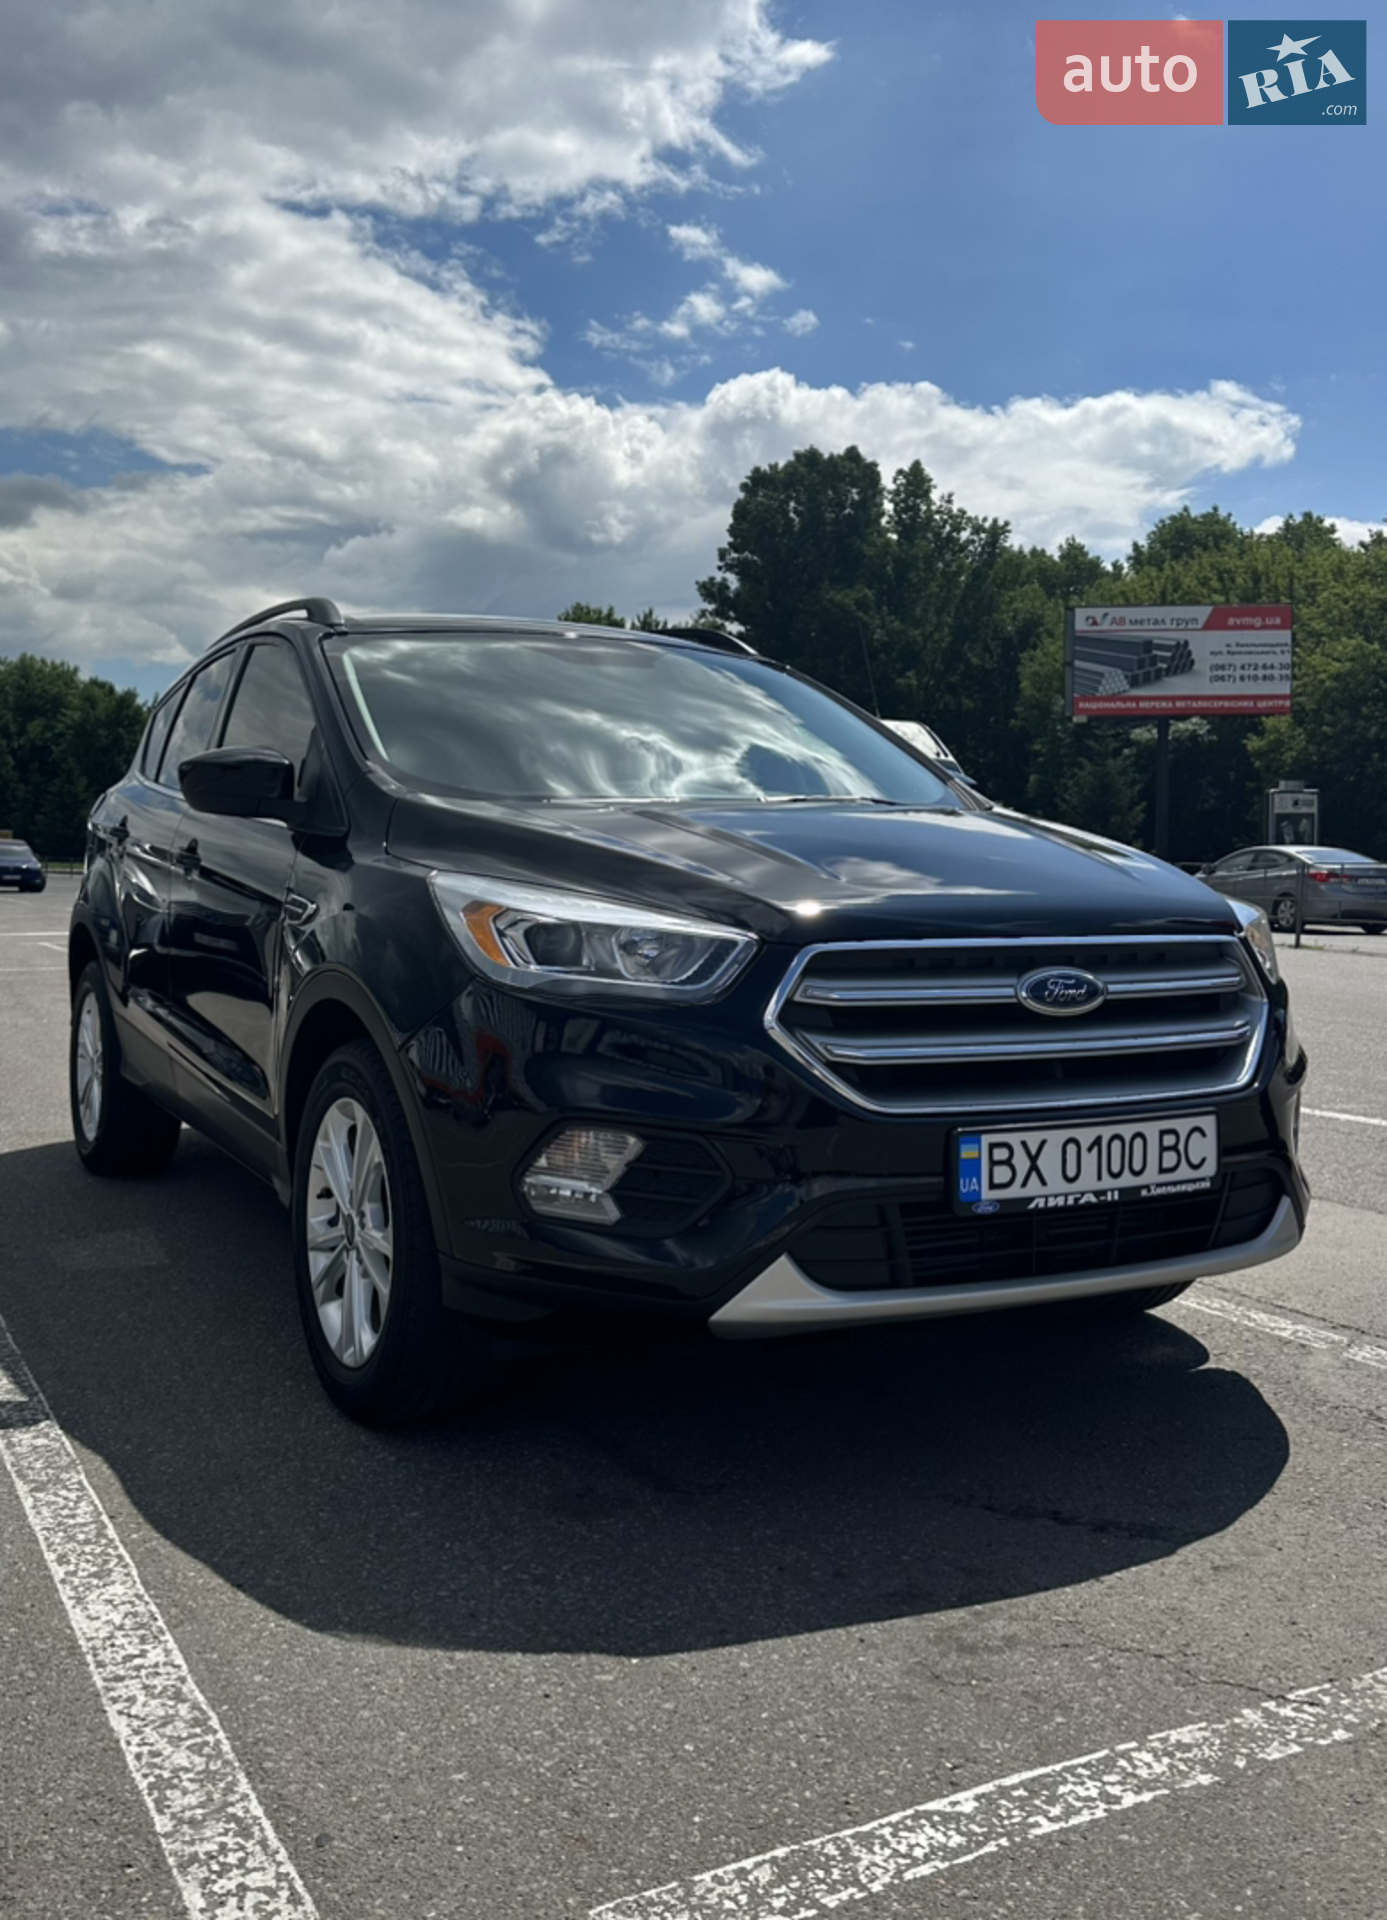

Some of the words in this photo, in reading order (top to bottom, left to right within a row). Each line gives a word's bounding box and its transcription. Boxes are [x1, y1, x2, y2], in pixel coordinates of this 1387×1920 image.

[1128, 617, 1167, 627] метал
[1170, 617, 1200, 629] груп
[1226, 616, 1282, 629] avmg.ua
[1209, 663, 1237, 673] (067)
[1239, 662, 1291, 672] 472-64-30
[1209, 674, 1237, 684] (067)
[1139, 700, 1174, 708] МЕРЕЖА
[1044, 978, 1088, 1002] Ford
[1060, 1131, 1148, 1184] 0100
[959, 1177, 980, 1194] UA
